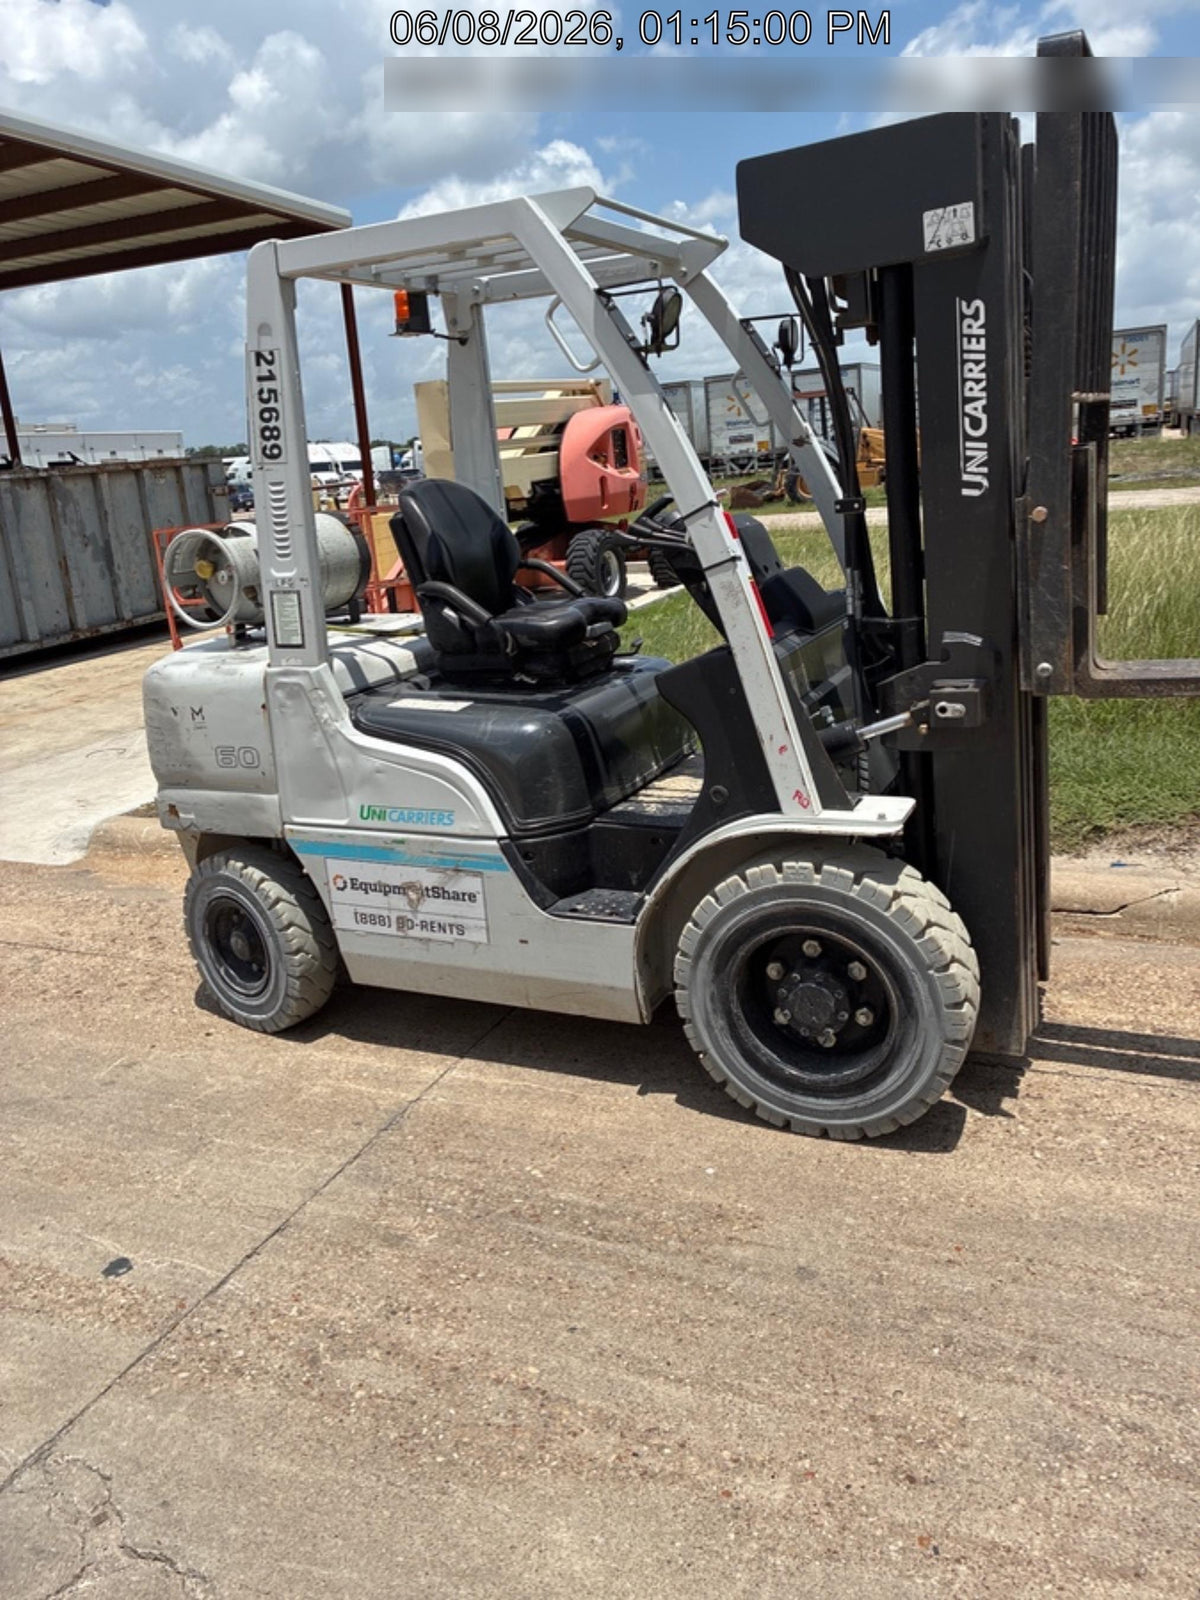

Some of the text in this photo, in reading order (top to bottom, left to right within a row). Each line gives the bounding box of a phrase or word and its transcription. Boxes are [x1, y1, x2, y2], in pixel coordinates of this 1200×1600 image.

[255, 350, 283, 461] 215689
[961, 298, 989, 497] UNICARRIERS
[215, 746, 260, 769] 60
[360, 805, 456, 826] UNICARRIERS
[349, 878, 478, 903] EquipmtShare
